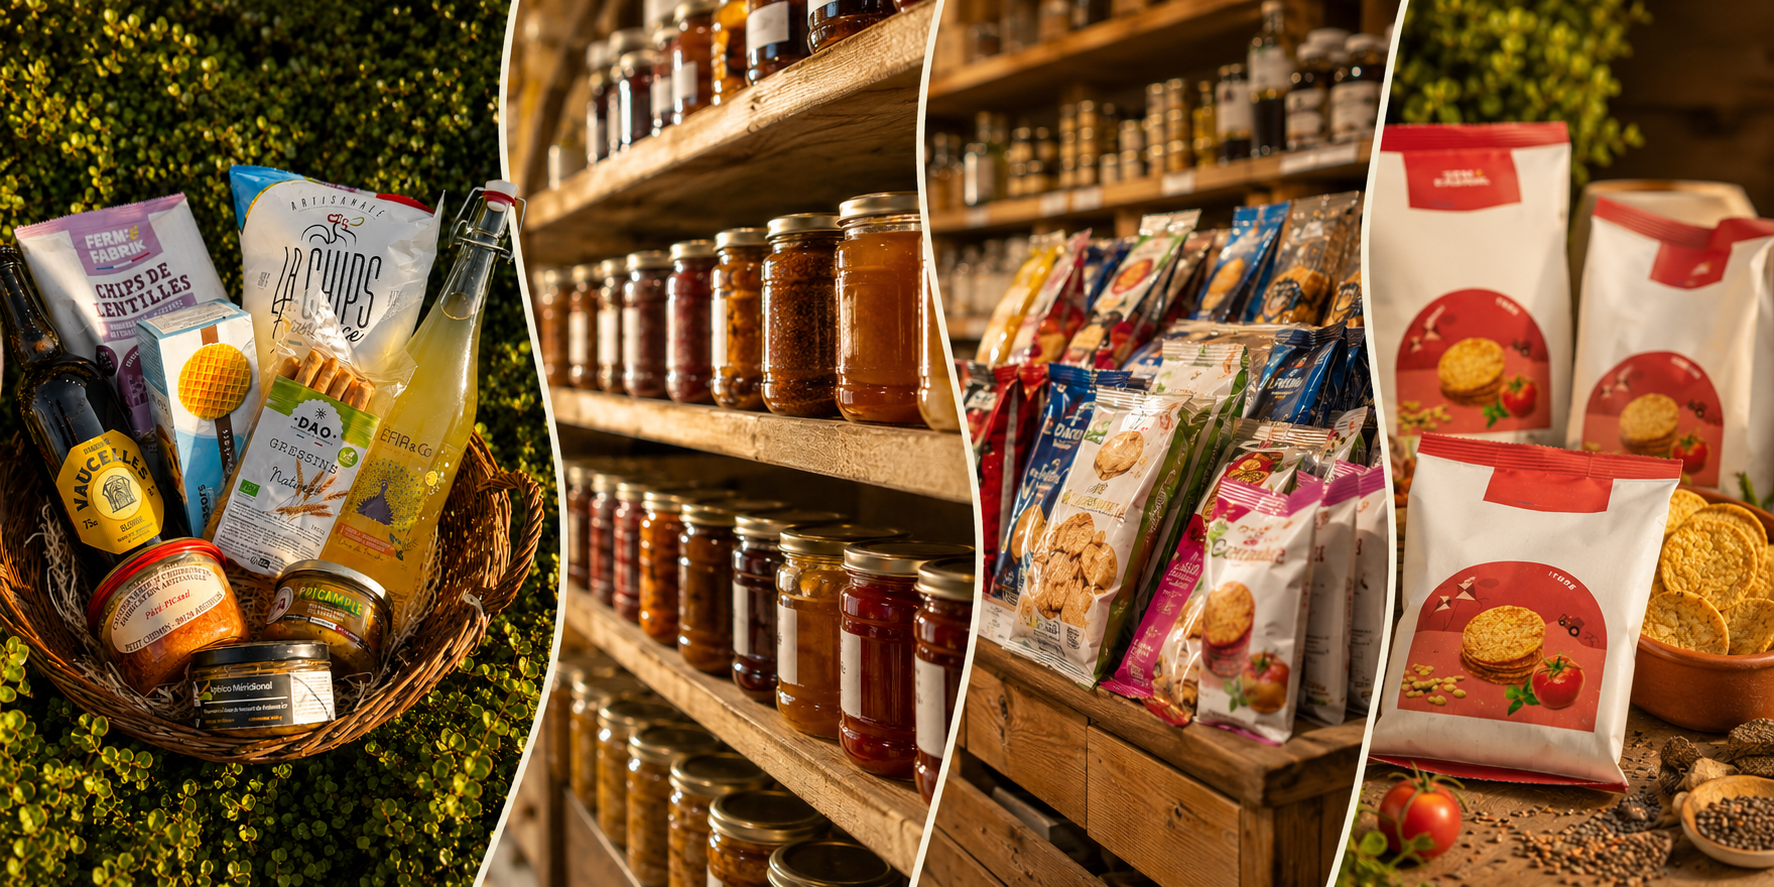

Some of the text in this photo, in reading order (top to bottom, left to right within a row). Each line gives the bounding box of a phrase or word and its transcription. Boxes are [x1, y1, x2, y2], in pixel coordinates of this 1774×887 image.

[291, 195, 385, 218] ARTISANALE
[89, 239, 147, 264] FABRIK
[93, 274, 192, 318] LENTILLES
[95, 262, 172, 299] CHIPS DE
[302, 247, 382, 329] CHIPS
[298, 416, 331, 439] DAO
[269, 437, 339, 475] GRESSINS
